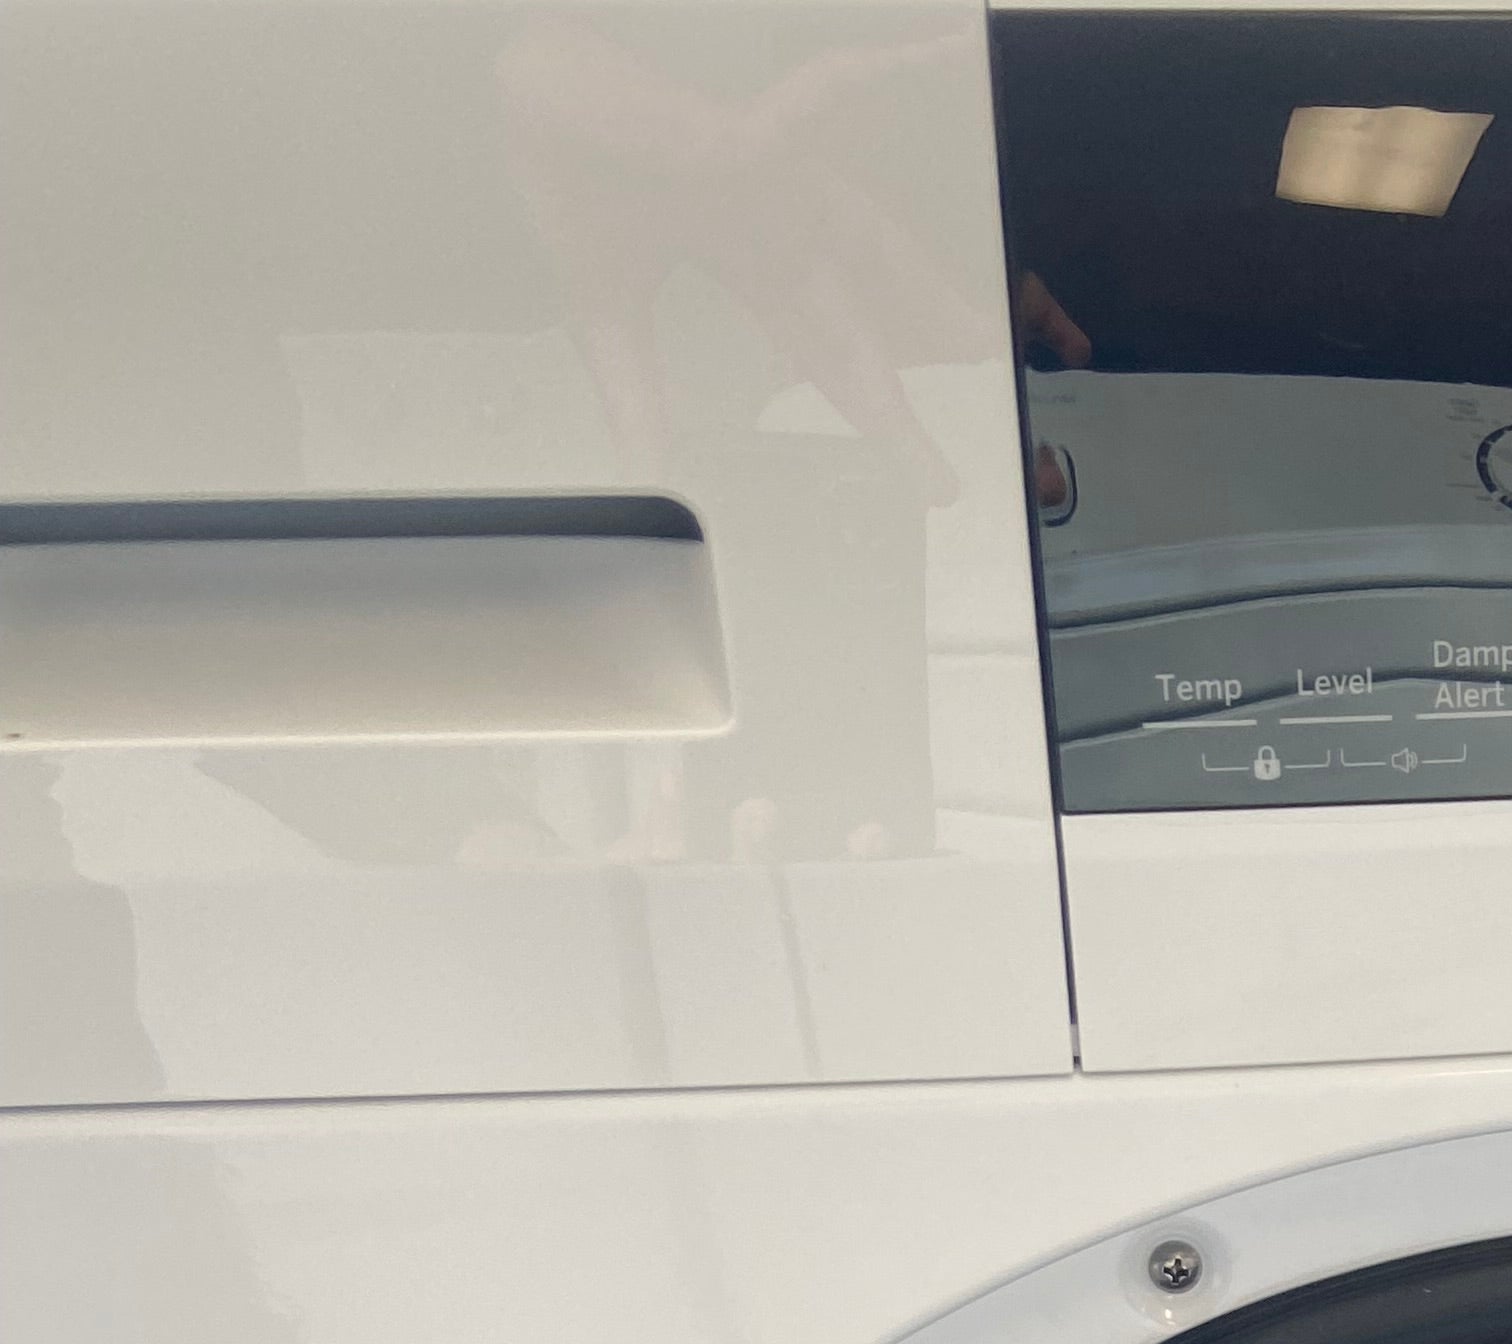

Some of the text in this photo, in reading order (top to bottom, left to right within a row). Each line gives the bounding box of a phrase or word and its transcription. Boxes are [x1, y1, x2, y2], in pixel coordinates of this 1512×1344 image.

[1156, 672, 1243, 706] Temp
[1295, 668, 1373, 696] Level
[1434, 681, 1505, 711] Alert
